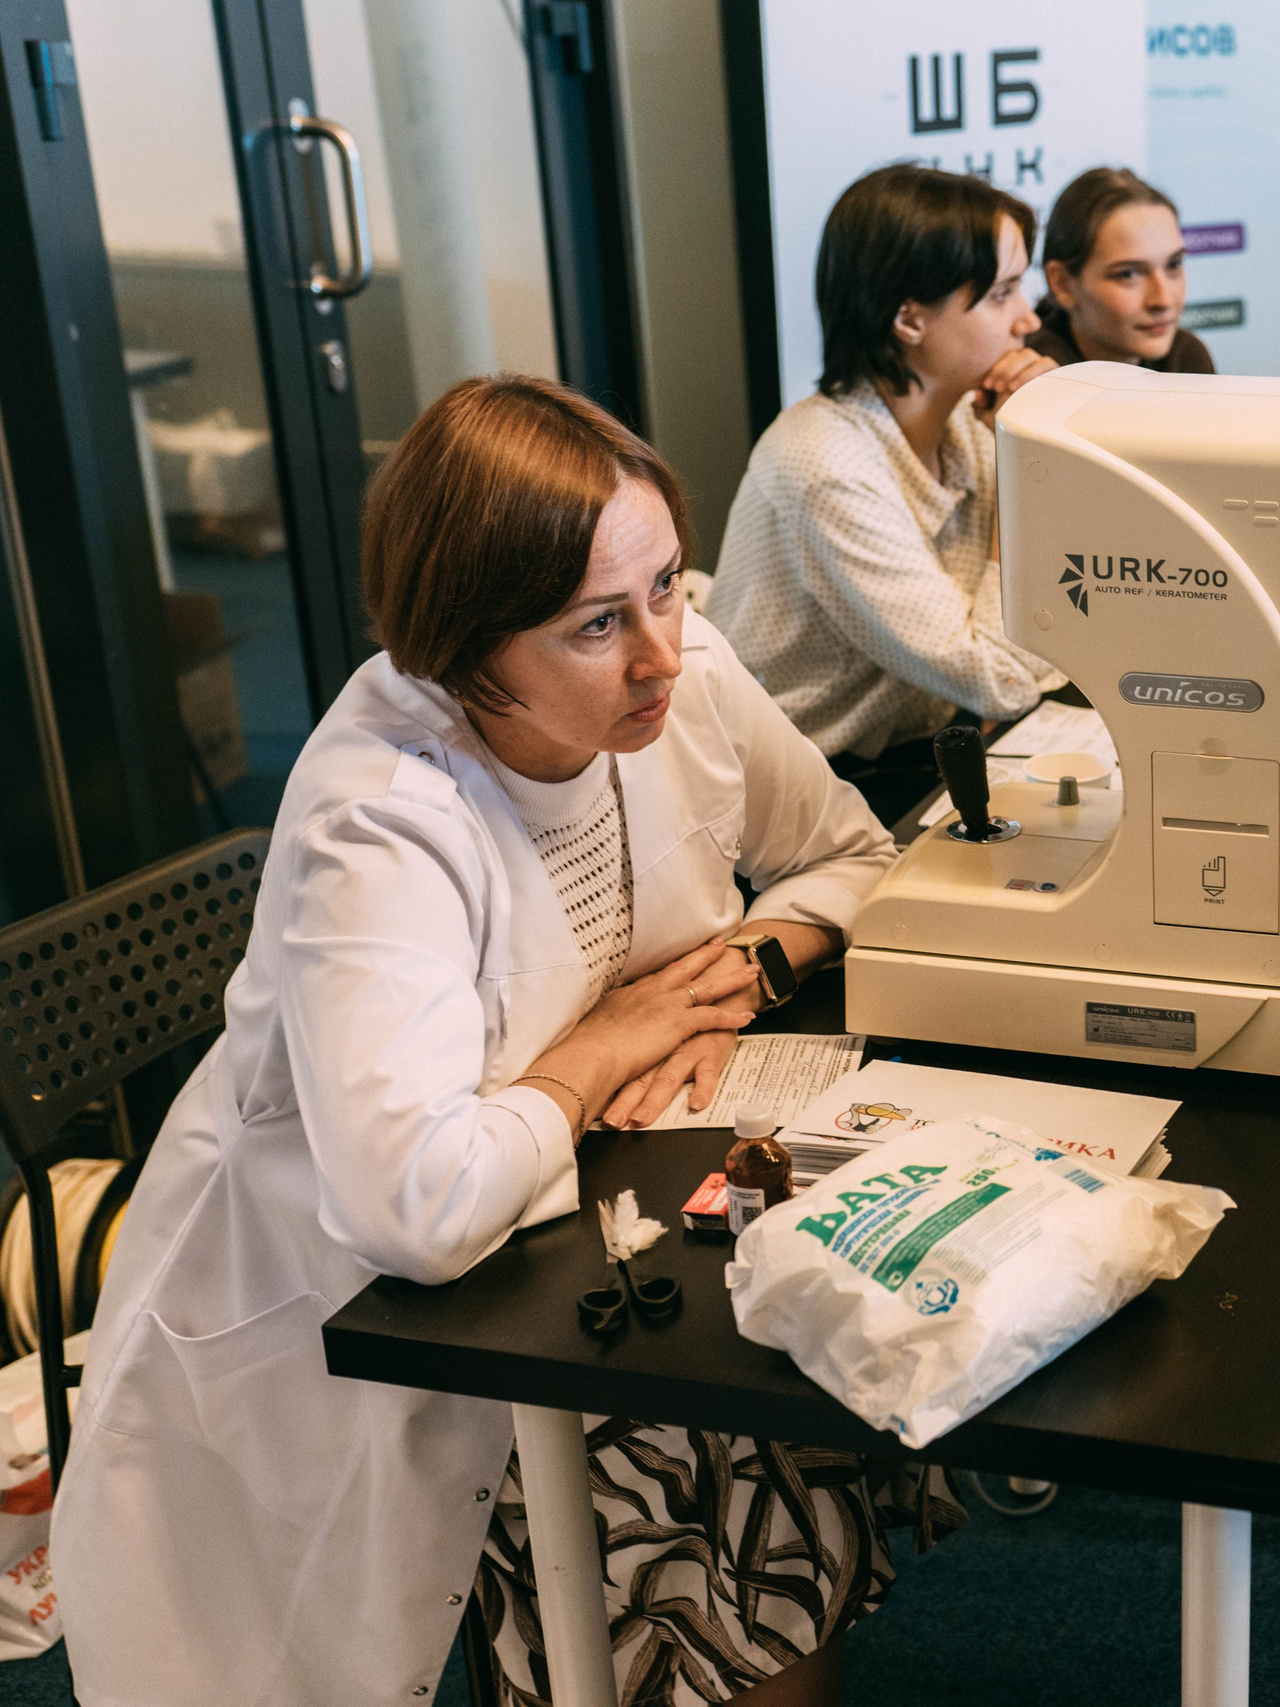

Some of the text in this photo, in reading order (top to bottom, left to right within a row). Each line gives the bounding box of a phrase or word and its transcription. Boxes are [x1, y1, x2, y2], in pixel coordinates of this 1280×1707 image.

[909, 48, 1040, 134] Ш Б
[1092, 555, 1228, 588] URK-700
[1095, 585, 1121, 594] AUTO
[1125, 587, 1144, 595] REF
[1155, 589, 1228, 601] KERATOMETER
[1134, 681, 1247, 706] unicos
[1204, 897, 1225, 905] PRINT
